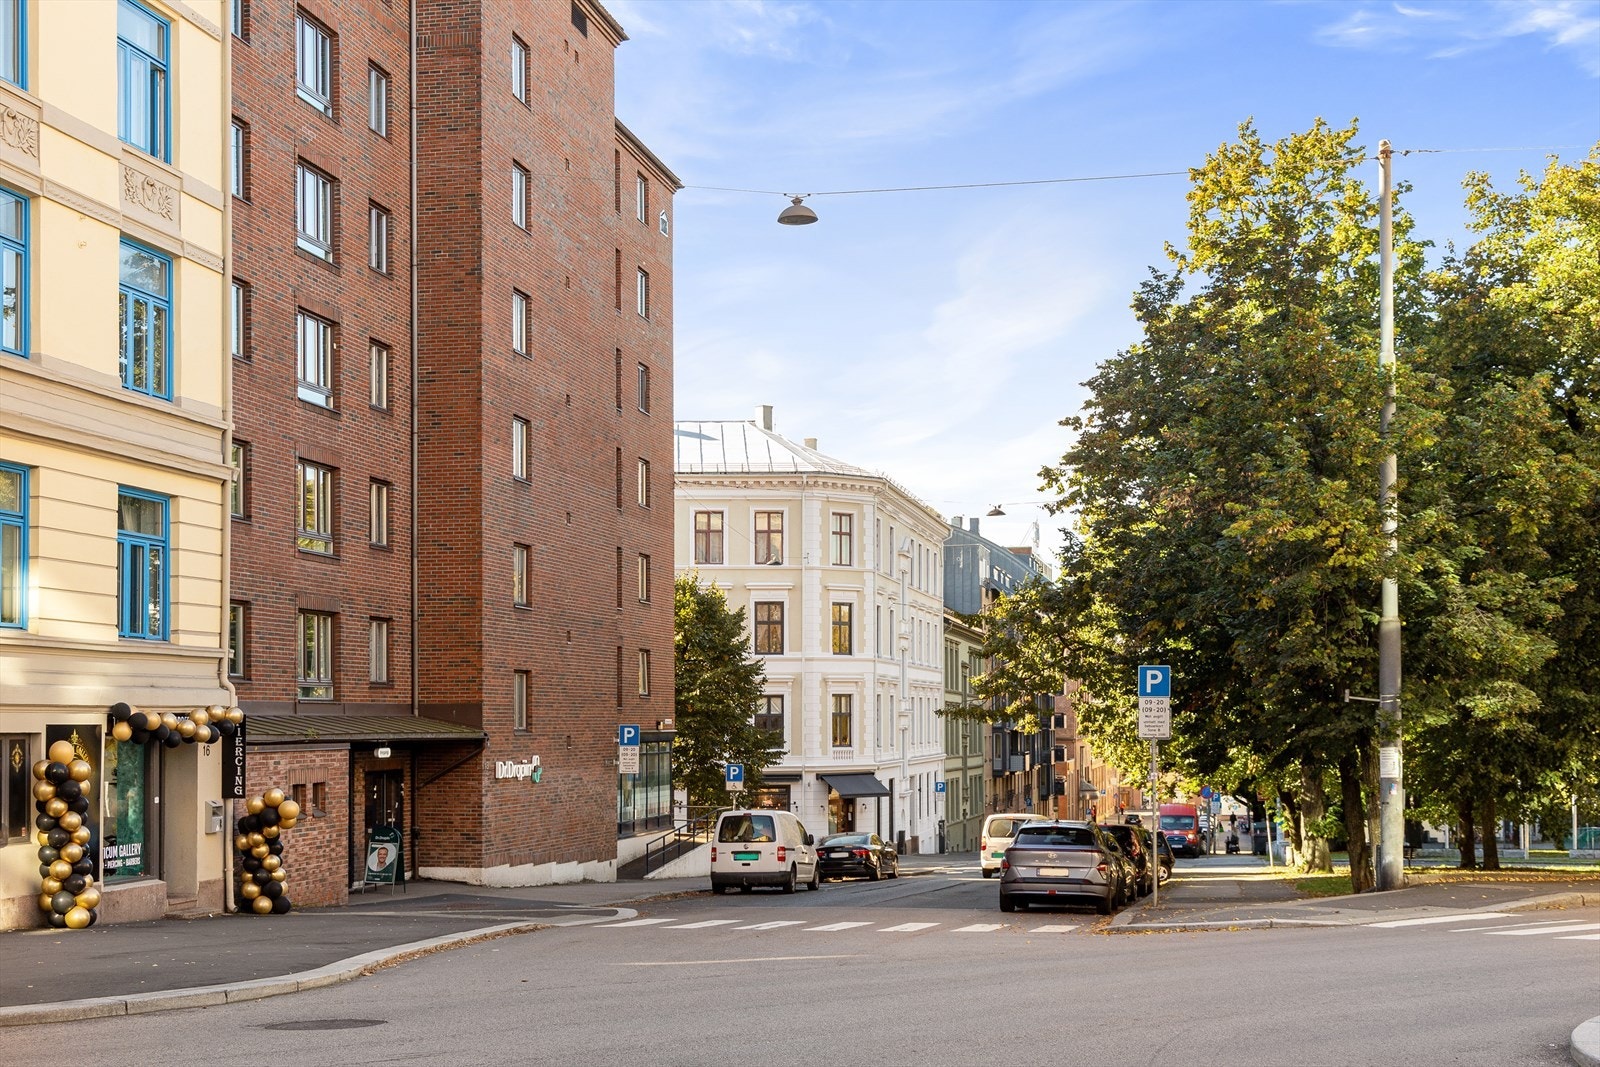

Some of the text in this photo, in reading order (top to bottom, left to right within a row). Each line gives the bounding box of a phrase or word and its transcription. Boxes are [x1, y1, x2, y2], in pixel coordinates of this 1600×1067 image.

[1146, 670, 1163, 693] P
[624, 727, 635, 744] P
[203, 745, 211, 757] 16
[234, 723, 243, 796] IERCING
[730, 766, 739, 780] P
[937, 783, 944, 791] P
[103, 843, 142, 859] ICUM GALLERY
